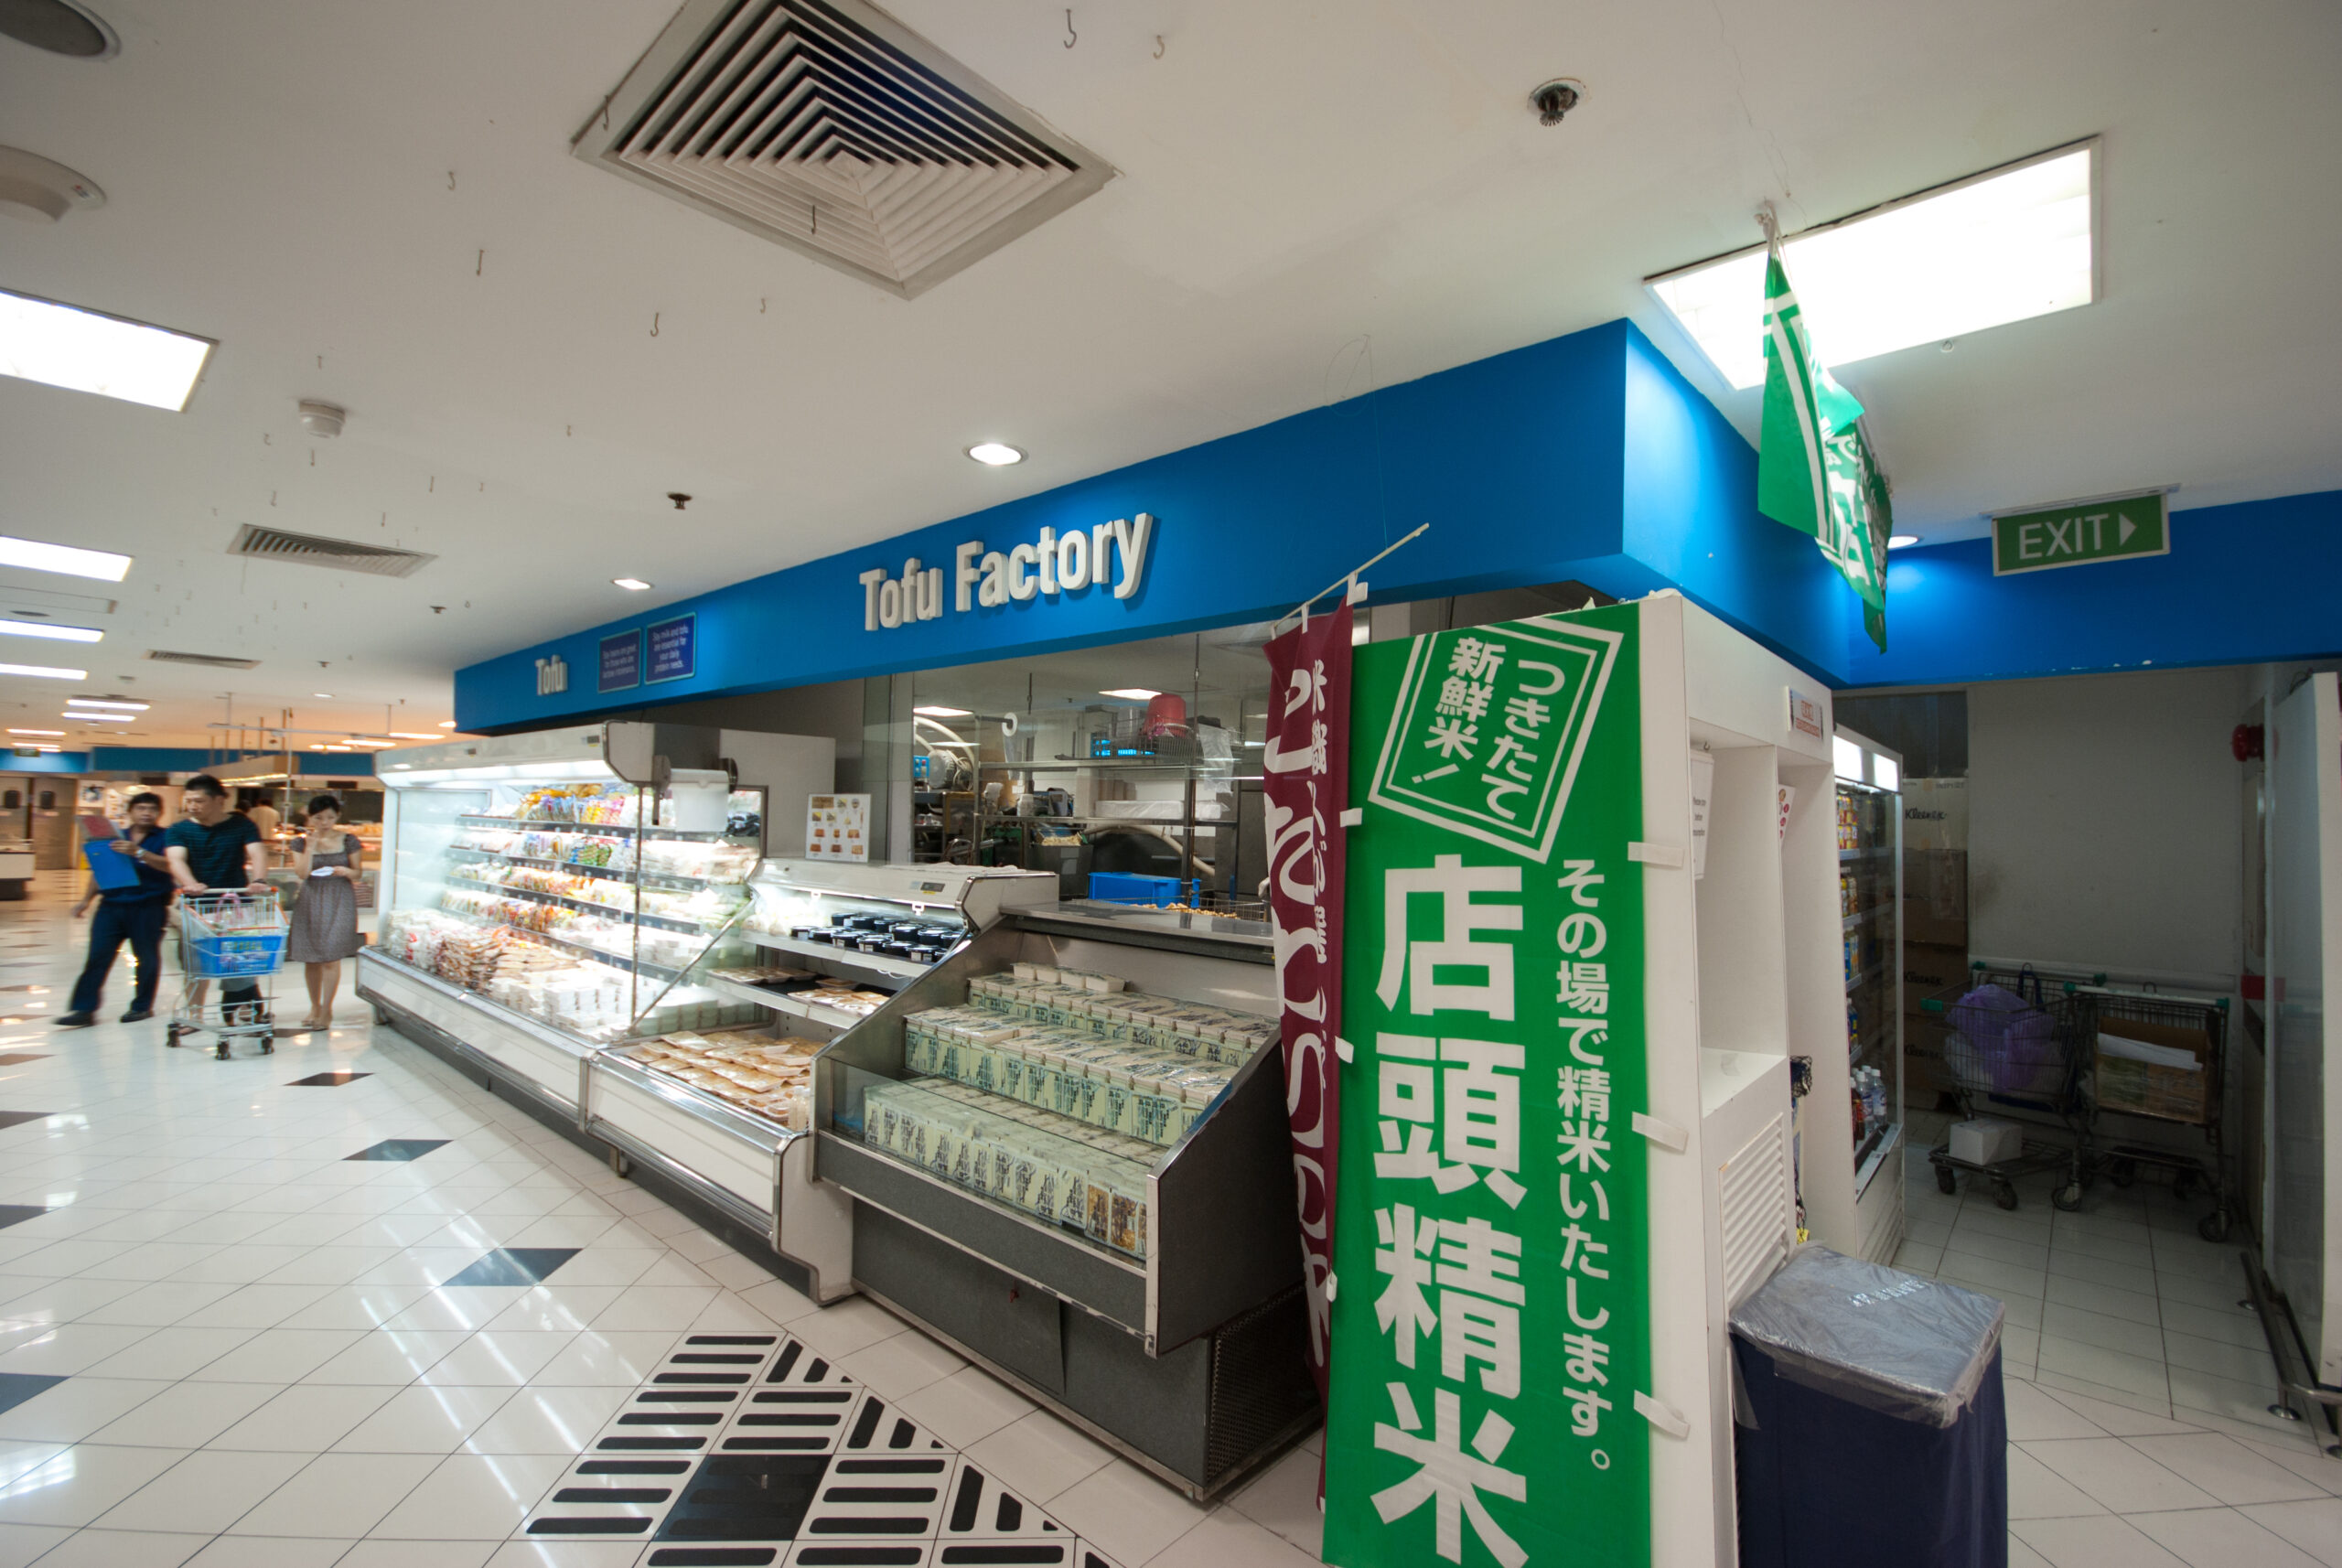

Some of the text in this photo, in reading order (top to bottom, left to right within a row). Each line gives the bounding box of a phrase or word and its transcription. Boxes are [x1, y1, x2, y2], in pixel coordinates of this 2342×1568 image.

[859, 512, 1153, 631] Tofu Factory
[2019, 513, 2109, 560] EXIT
[535, 655, 567, 695] Tofu
[1481, 660, 1565, 821] つきたて
[1905, 807, 1947, 820] Kleenex
[1370, 854, 1530, 1568] 店頭精米
[1556, 859, 1613, 1470] その場で精米いたします。
